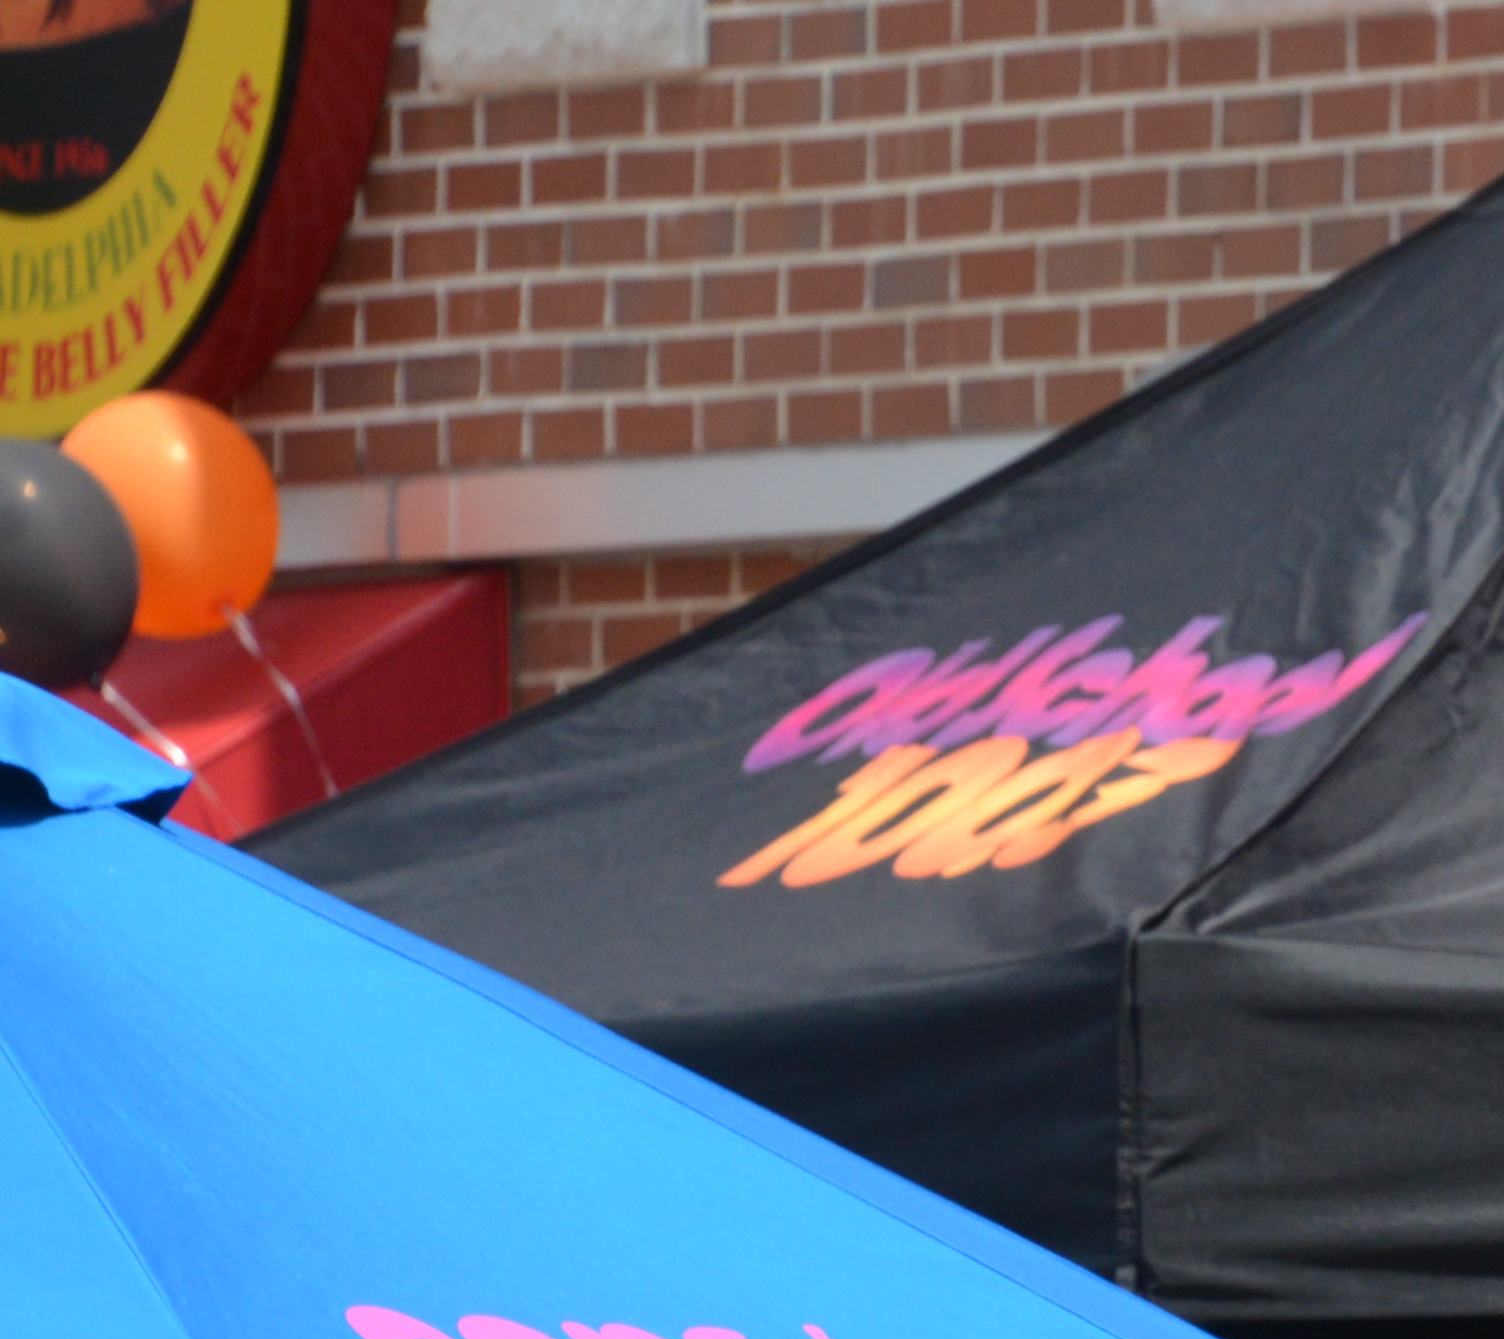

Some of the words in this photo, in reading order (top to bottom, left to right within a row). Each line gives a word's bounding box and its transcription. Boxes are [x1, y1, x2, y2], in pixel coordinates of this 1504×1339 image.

[0, 166, 177, 314] DELPHIA
[33, 293, 147, 401] BELLY
[156, 72, 262, 314] FILLER
